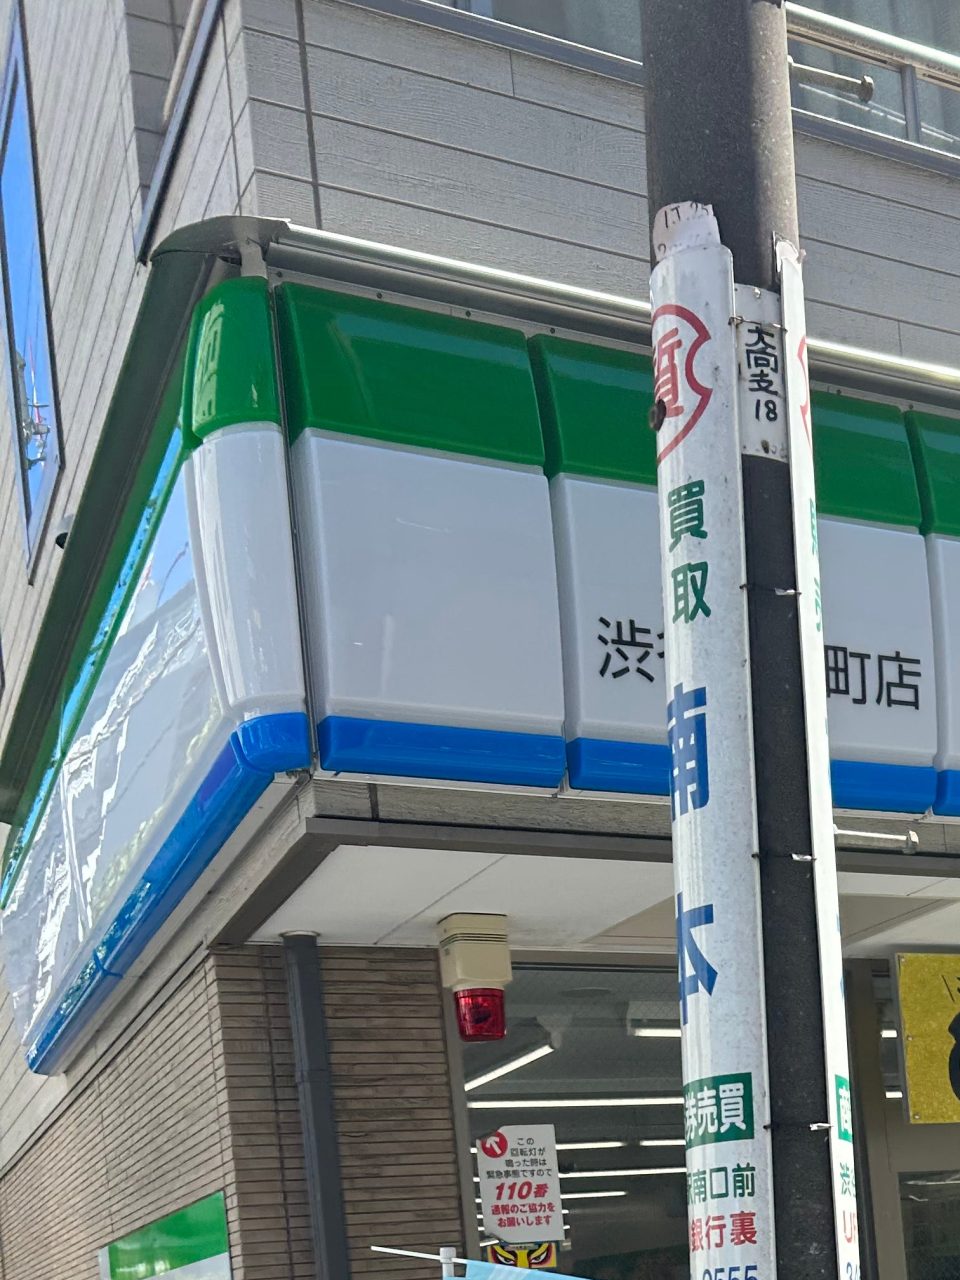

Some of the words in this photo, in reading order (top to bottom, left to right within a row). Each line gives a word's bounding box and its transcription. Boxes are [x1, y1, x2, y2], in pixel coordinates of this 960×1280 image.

[667, 481, 711, 624] 買取
[517, 1138, 534, 1146] この
[496, 1181, 549, 1200] 110番
[491, 1202, 555, 1215] 通報のご協力を
[497, 1214, 552, 1227] お願いします
